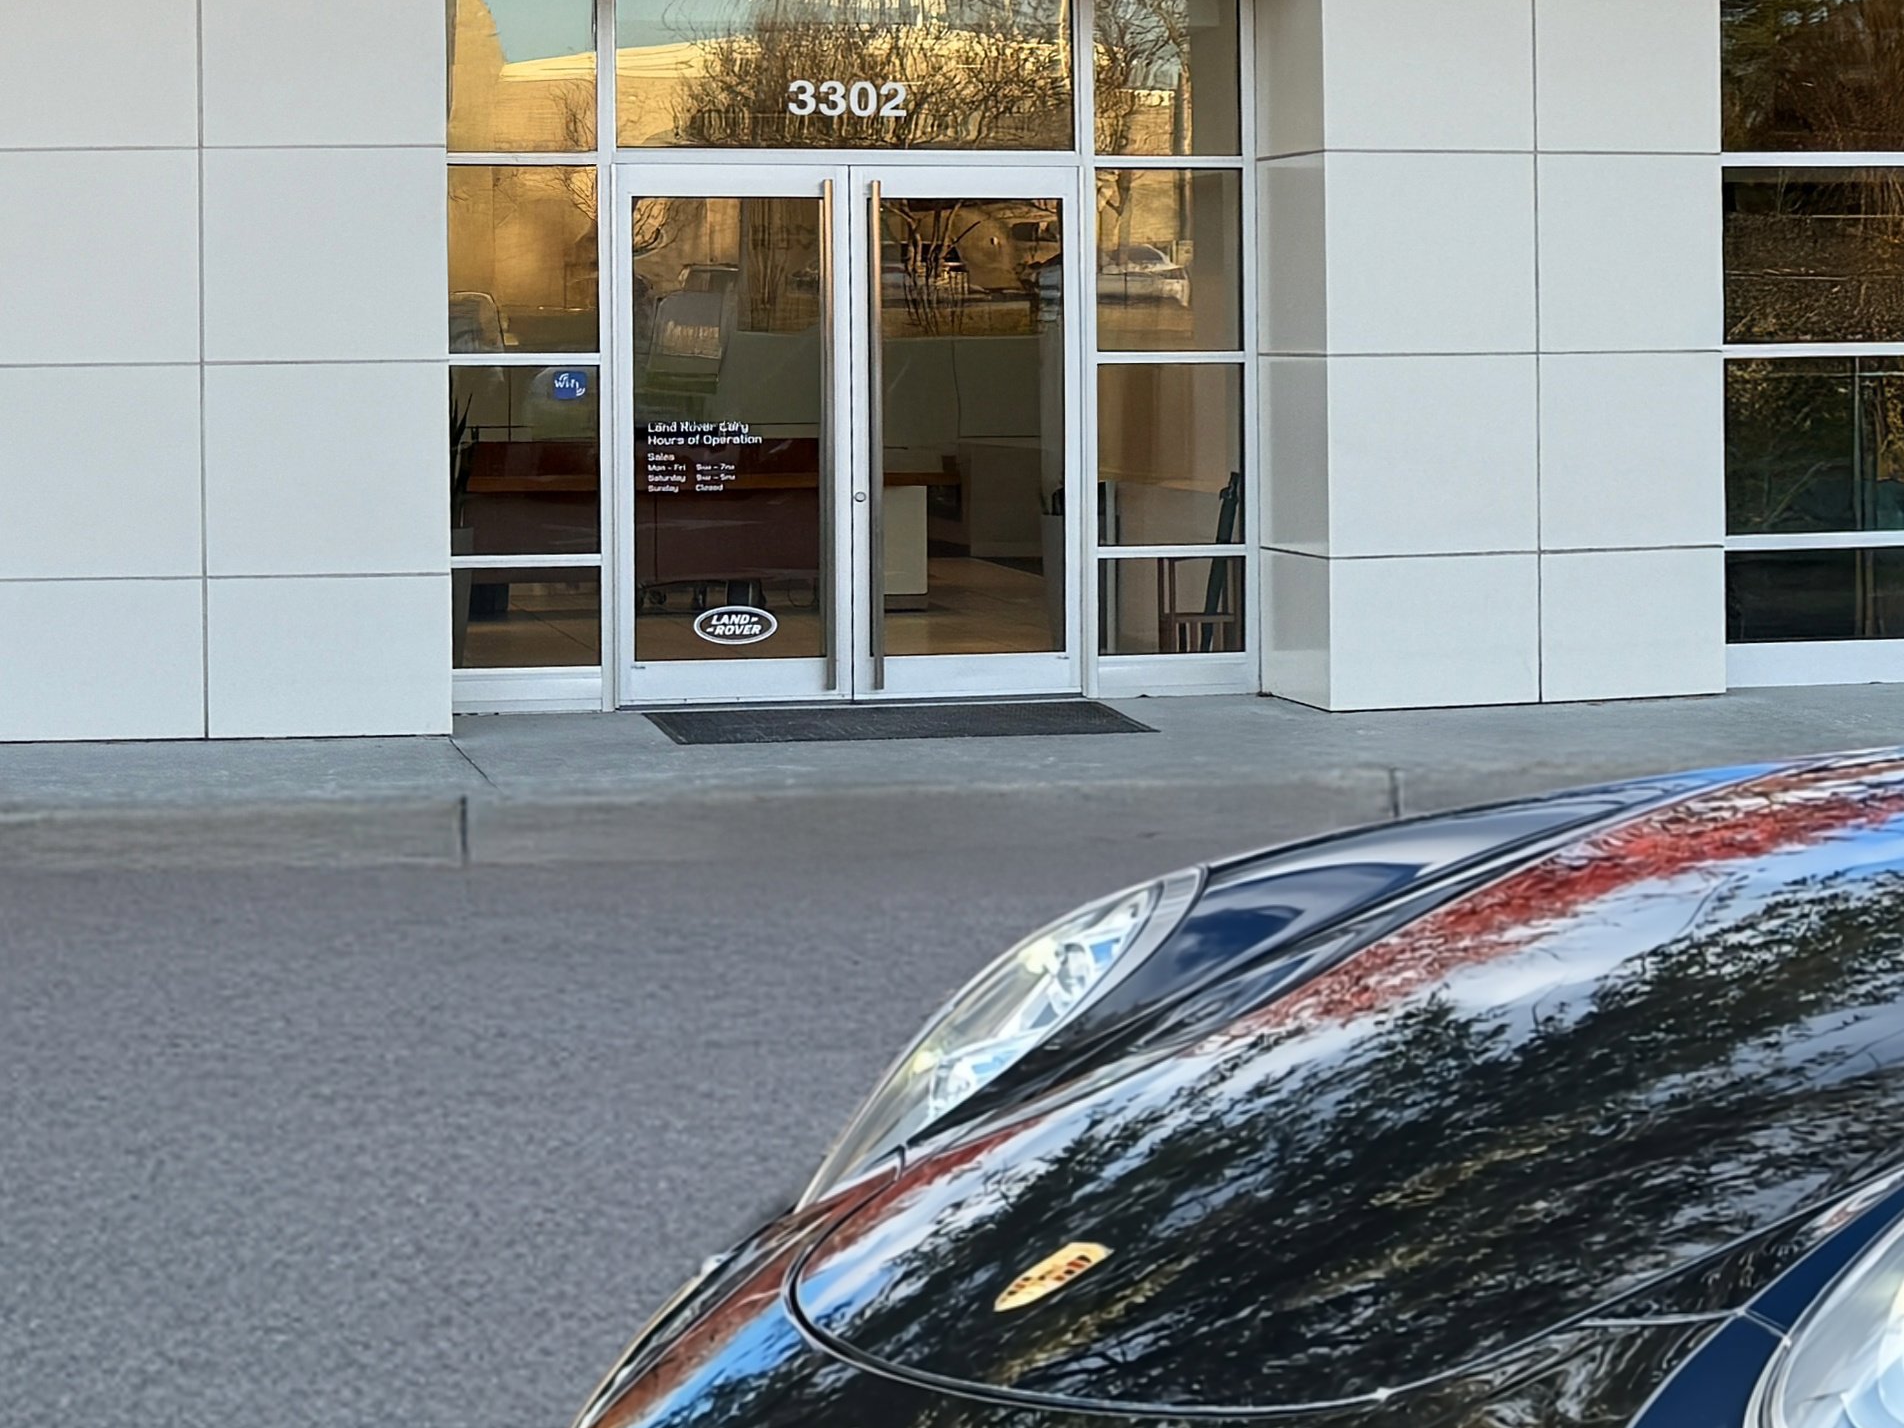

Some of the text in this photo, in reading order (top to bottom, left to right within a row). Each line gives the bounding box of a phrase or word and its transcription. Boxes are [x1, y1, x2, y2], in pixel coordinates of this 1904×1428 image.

[788, 80, 907, 117] 3302
[647, 434, 762, 447] Hours of Operation
[647, 452, 676, 461] Sales
[647, 474, 686, 483] Saturday
[647, 484, 679, 493] Sunday
[711, 614, 750, 625] LAND
[714, 624, 762, 636] ROVER
